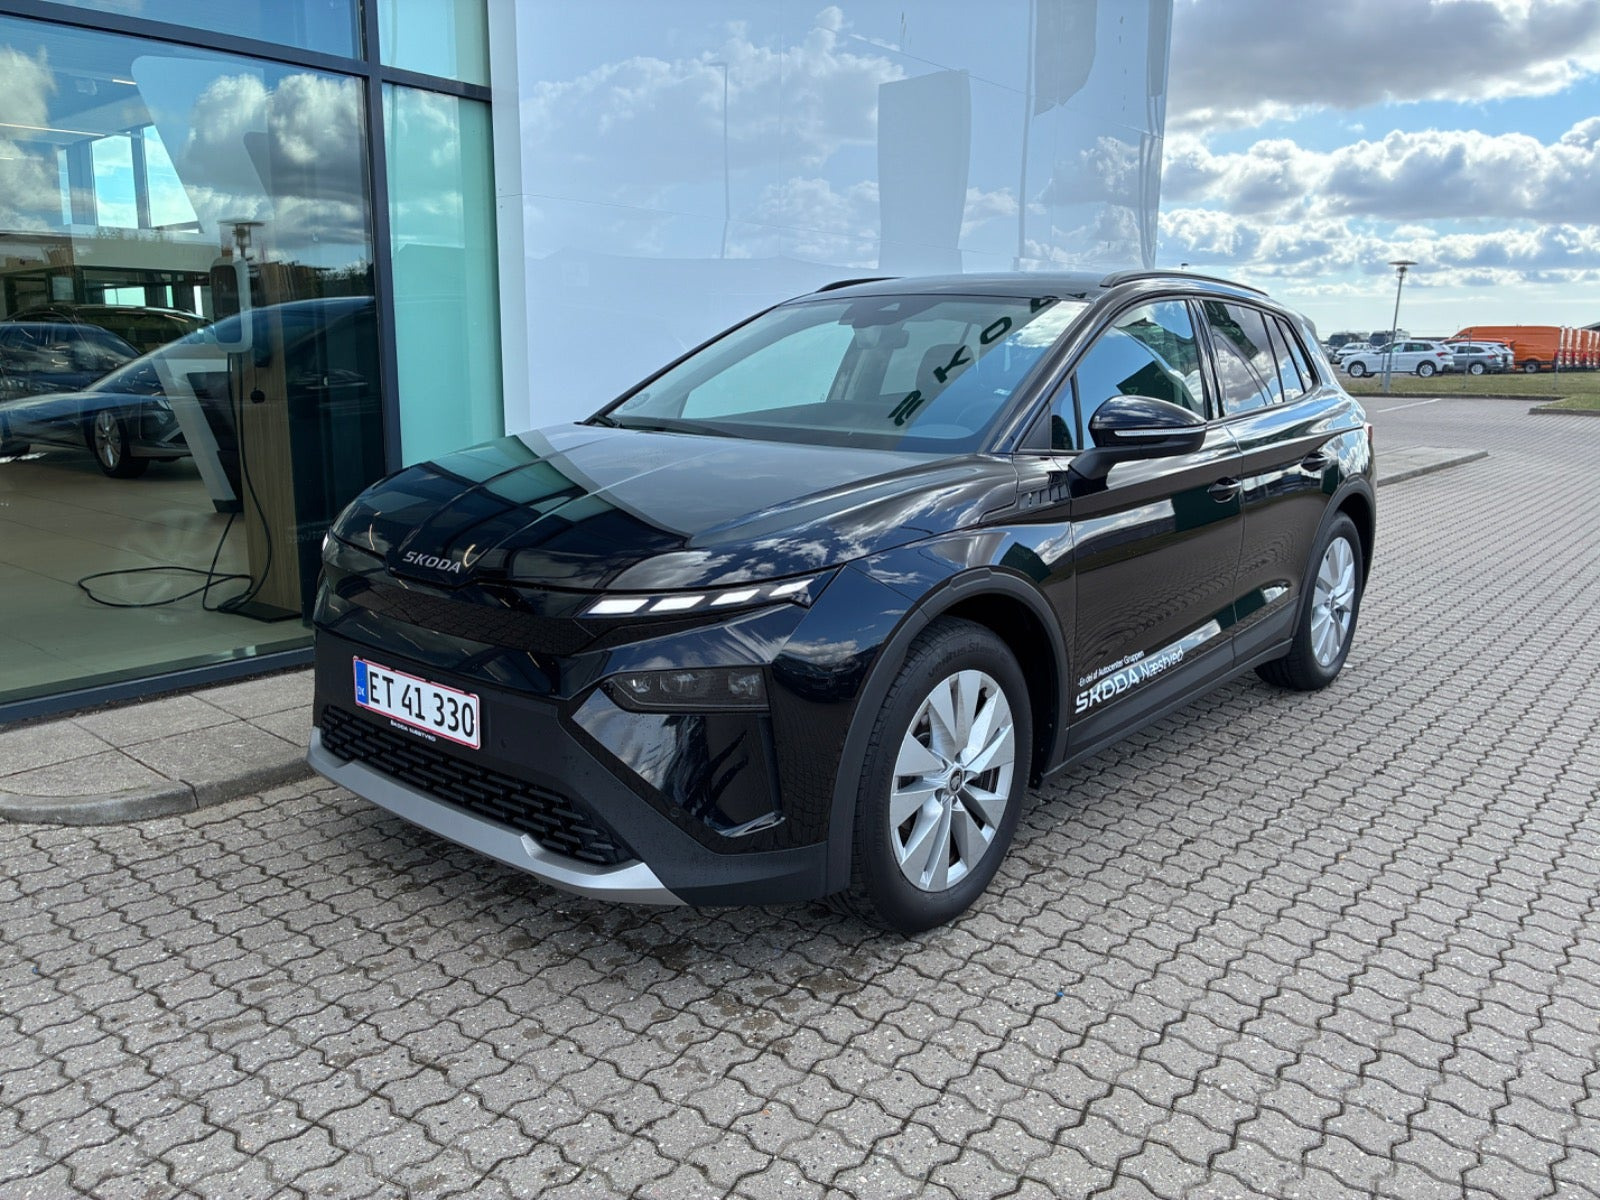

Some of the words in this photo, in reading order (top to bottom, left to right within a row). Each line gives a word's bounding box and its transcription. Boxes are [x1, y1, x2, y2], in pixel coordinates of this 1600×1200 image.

[369, 671, 394, 709] ET
[401, 683, 426, 722] 41
[433, 692, 475, 738] 330
